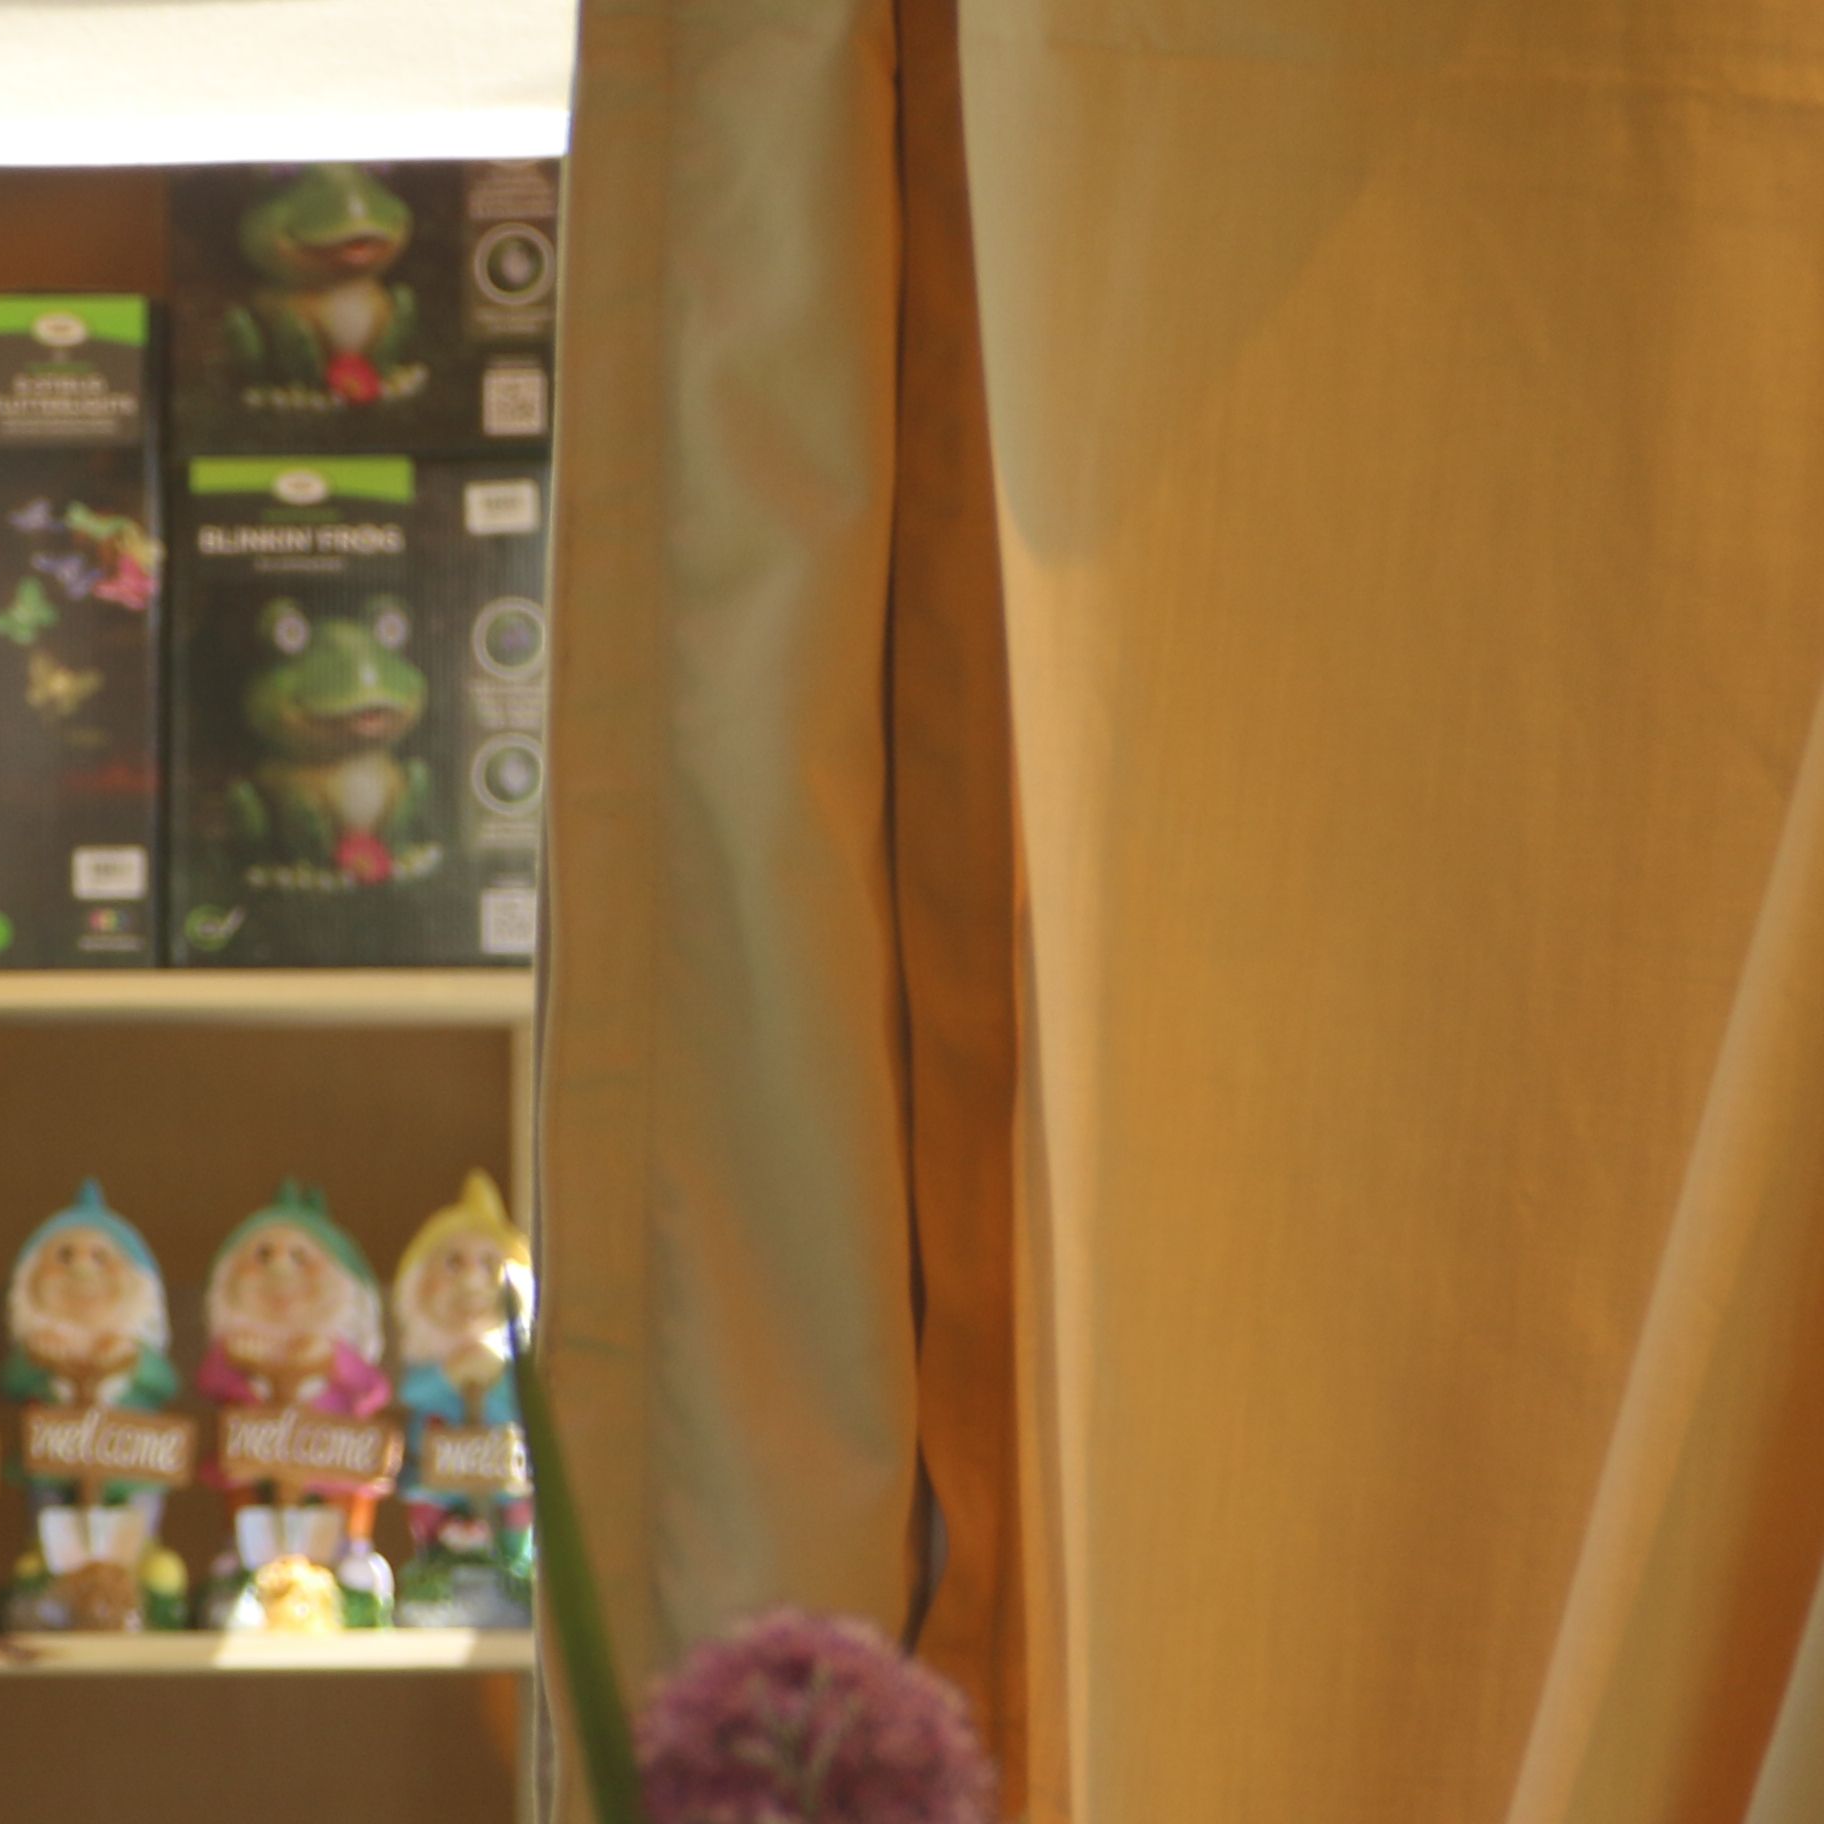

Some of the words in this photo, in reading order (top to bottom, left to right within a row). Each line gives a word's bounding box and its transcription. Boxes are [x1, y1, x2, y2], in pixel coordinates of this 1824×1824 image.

[315, 522, 405, 553] FROG
[30, 1407, 186, 1472] welcome
[226, 1407, 382, 1474] welcome
